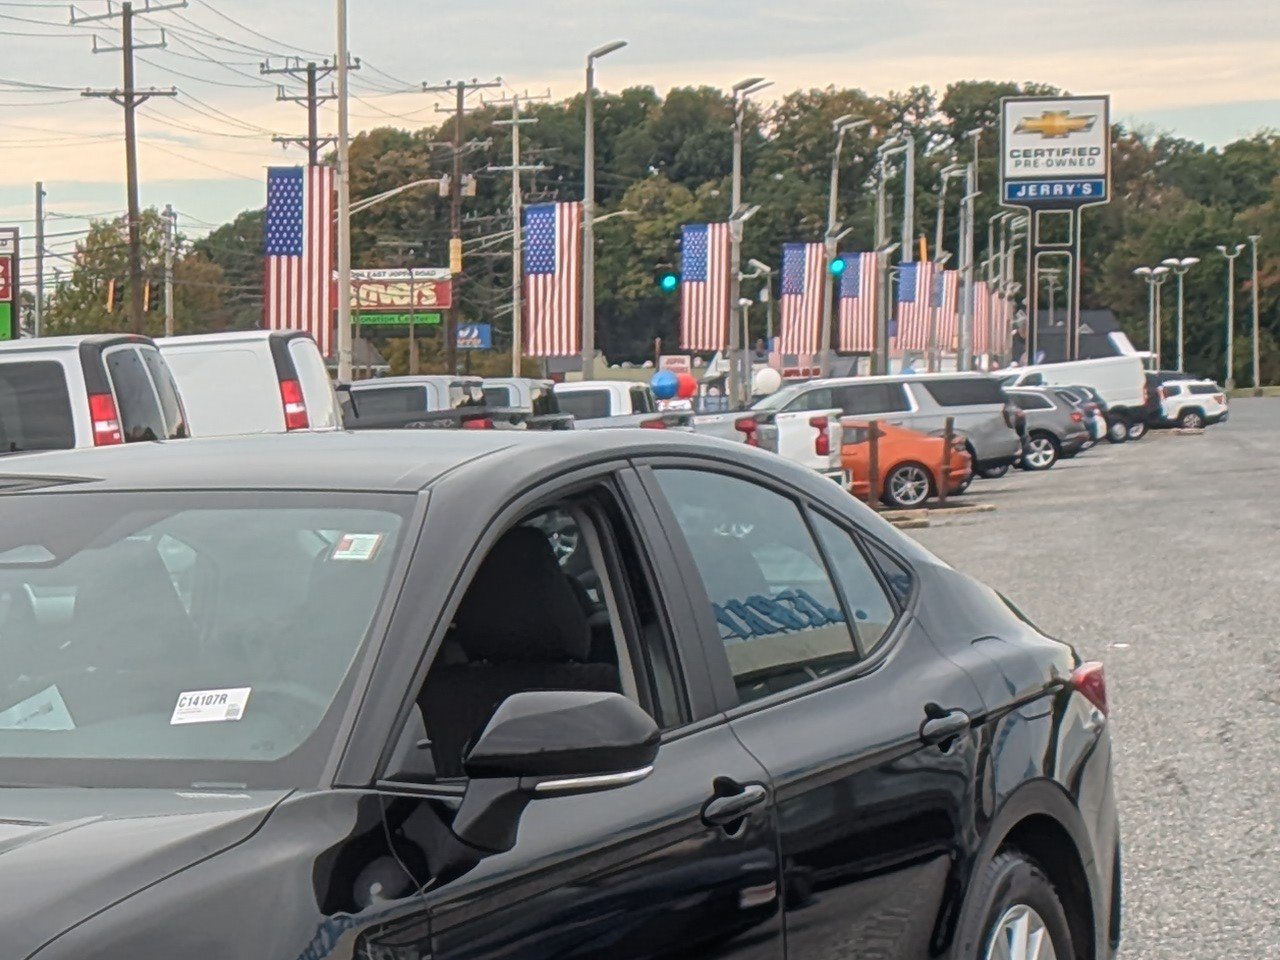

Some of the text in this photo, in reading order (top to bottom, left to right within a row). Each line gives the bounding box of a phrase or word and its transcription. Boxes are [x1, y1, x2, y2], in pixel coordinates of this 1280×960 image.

[1009, 146, 1101, 159] CERTIFIED
[1014, 157, 1096, 168] PRE-OWNED
[1016, 183, 1093, 197] JERRY'S
[178, 693, 229, 708] C14107R
